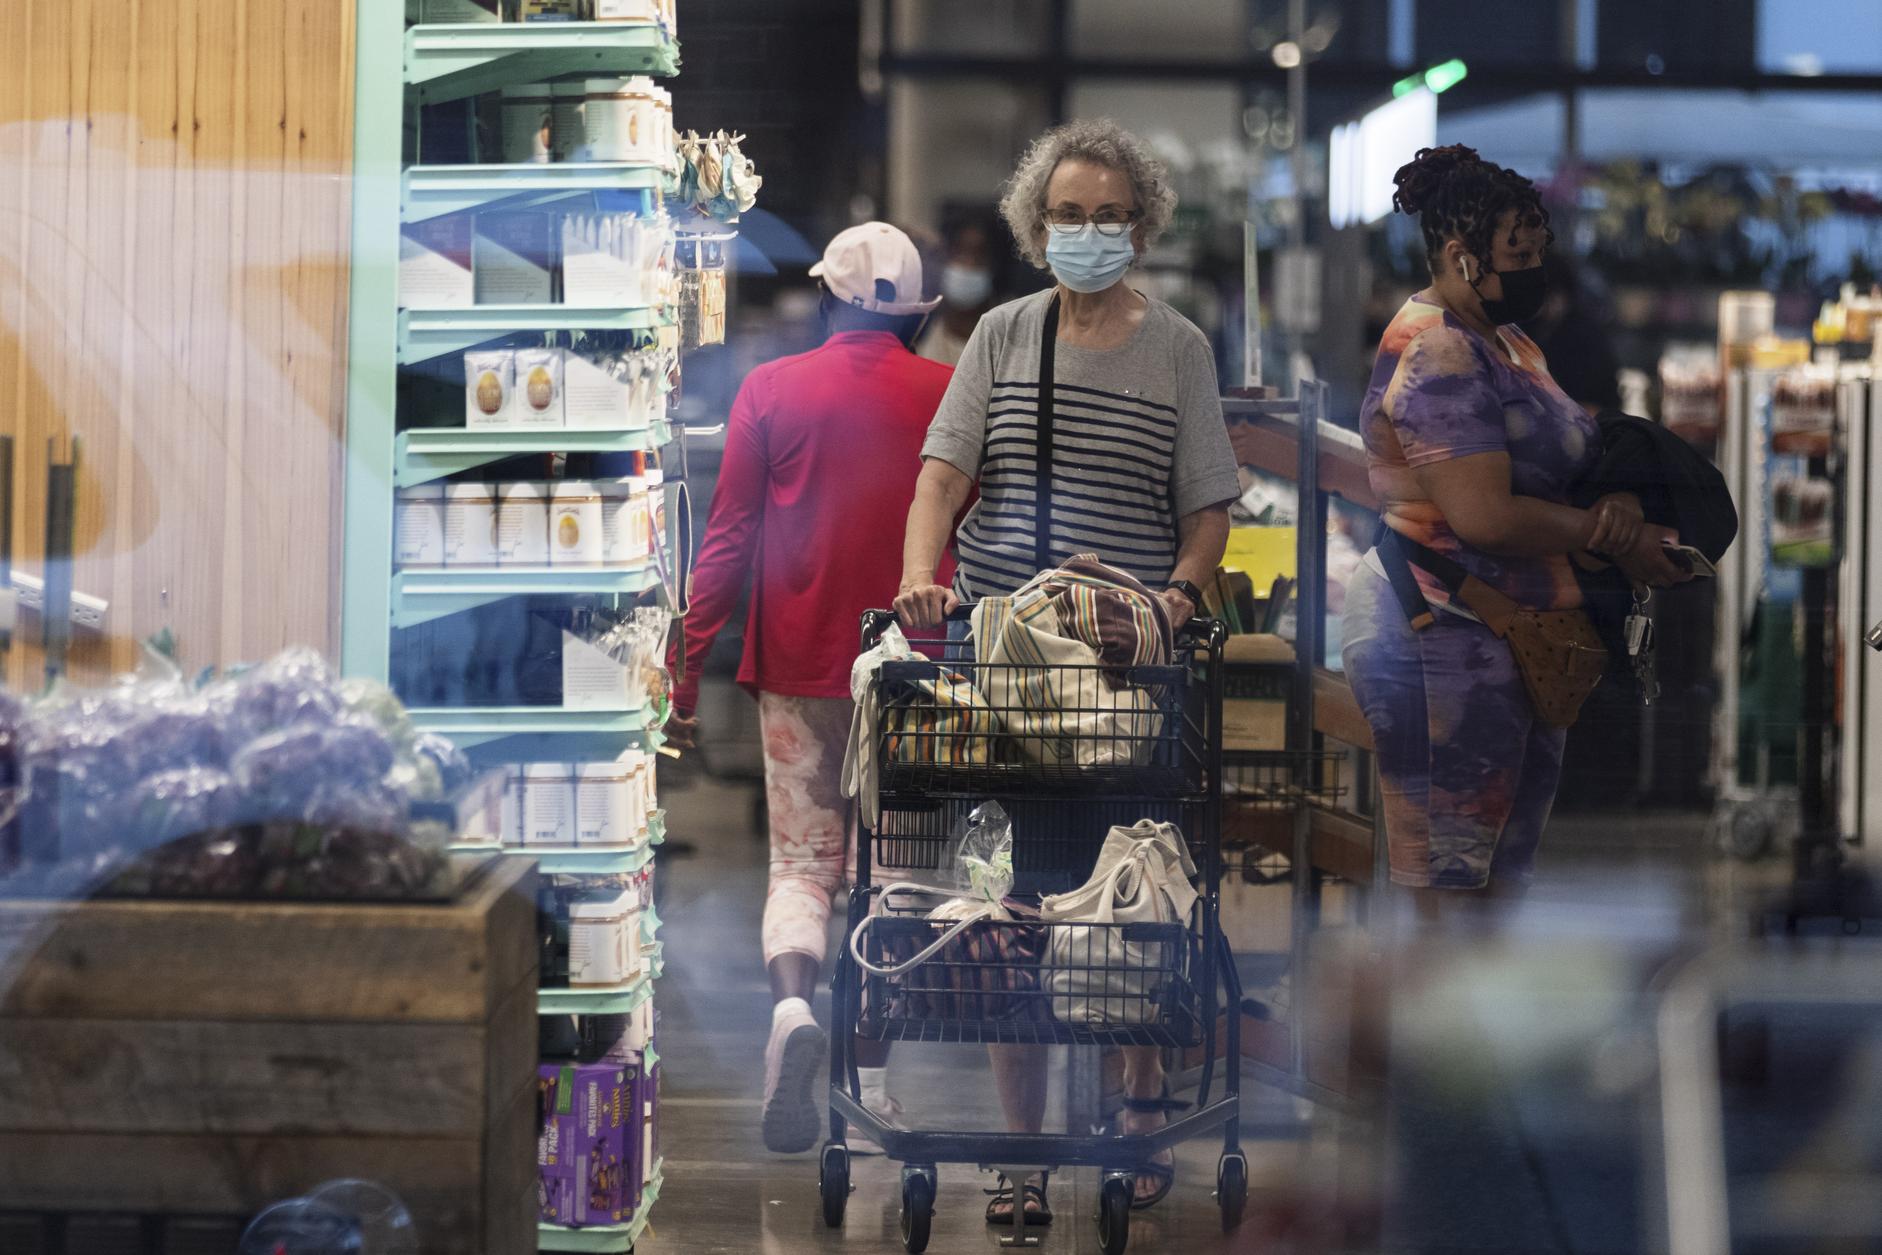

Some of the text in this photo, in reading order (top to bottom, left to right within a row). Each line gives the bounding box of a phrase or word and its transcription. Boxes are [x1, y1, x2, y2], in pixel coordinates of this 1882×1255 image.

[588, 1082, 597, 1138] FAVORITES PACK
[611, 1088, 621, 1128] Annie's
[548, 1127, 559, 1153] PACK
